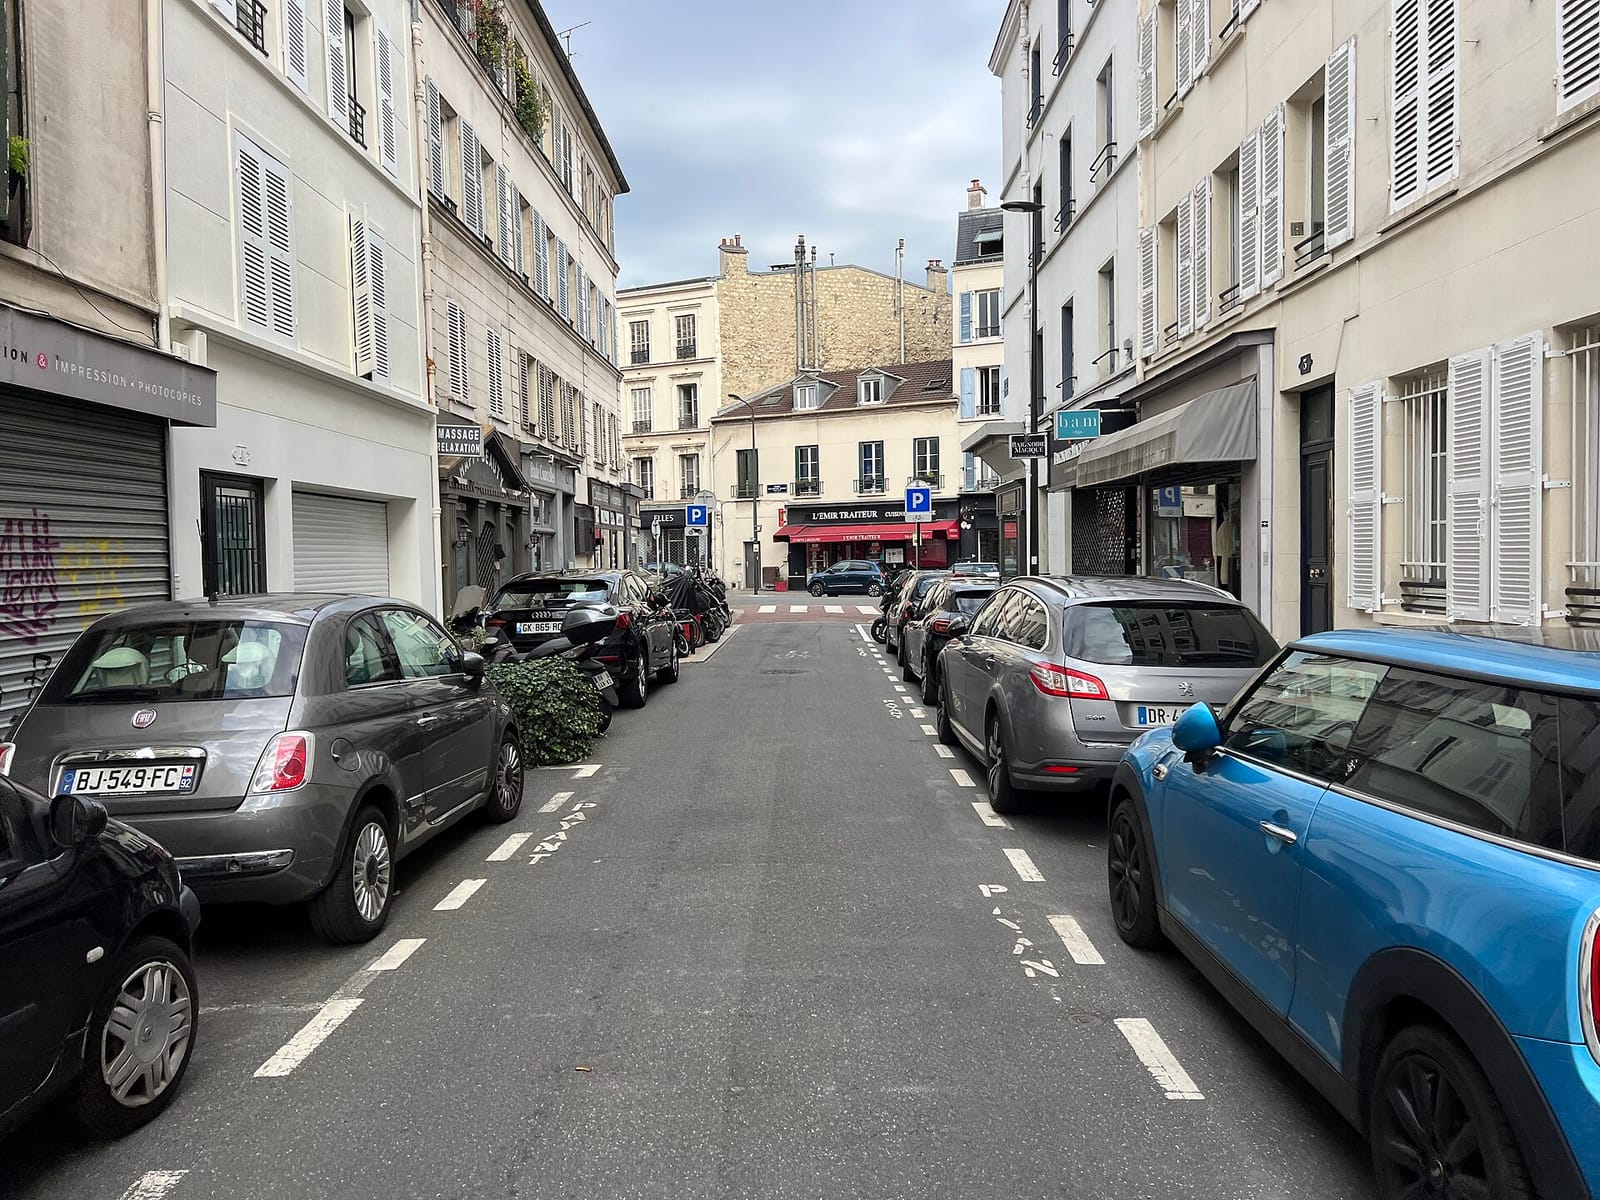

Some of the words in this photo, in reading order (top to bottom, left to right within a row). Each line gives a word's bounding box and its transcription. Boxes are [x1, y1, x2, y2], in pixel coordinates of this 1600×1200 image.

[0, 345, 28, 364] ION
[55, 355, 126, 388] IMPRESSION
[138, 380, 202, 406] PHOTOCOPIES
[438, 428, 479, 440] MASSAGE
[437, 441, 480, 454] RELAXATION
[912, 492, 924, 509] P
[691, 508, 702, 522] P
[812, 512, 839, 520] L'EMIR
[839, 510, 878, 519] TRAITEUR
[136, 713, 153, 723] FIAT
[76, 767, 178, 791] BJ-549-FC
[180, 778, 192, 788] 92
